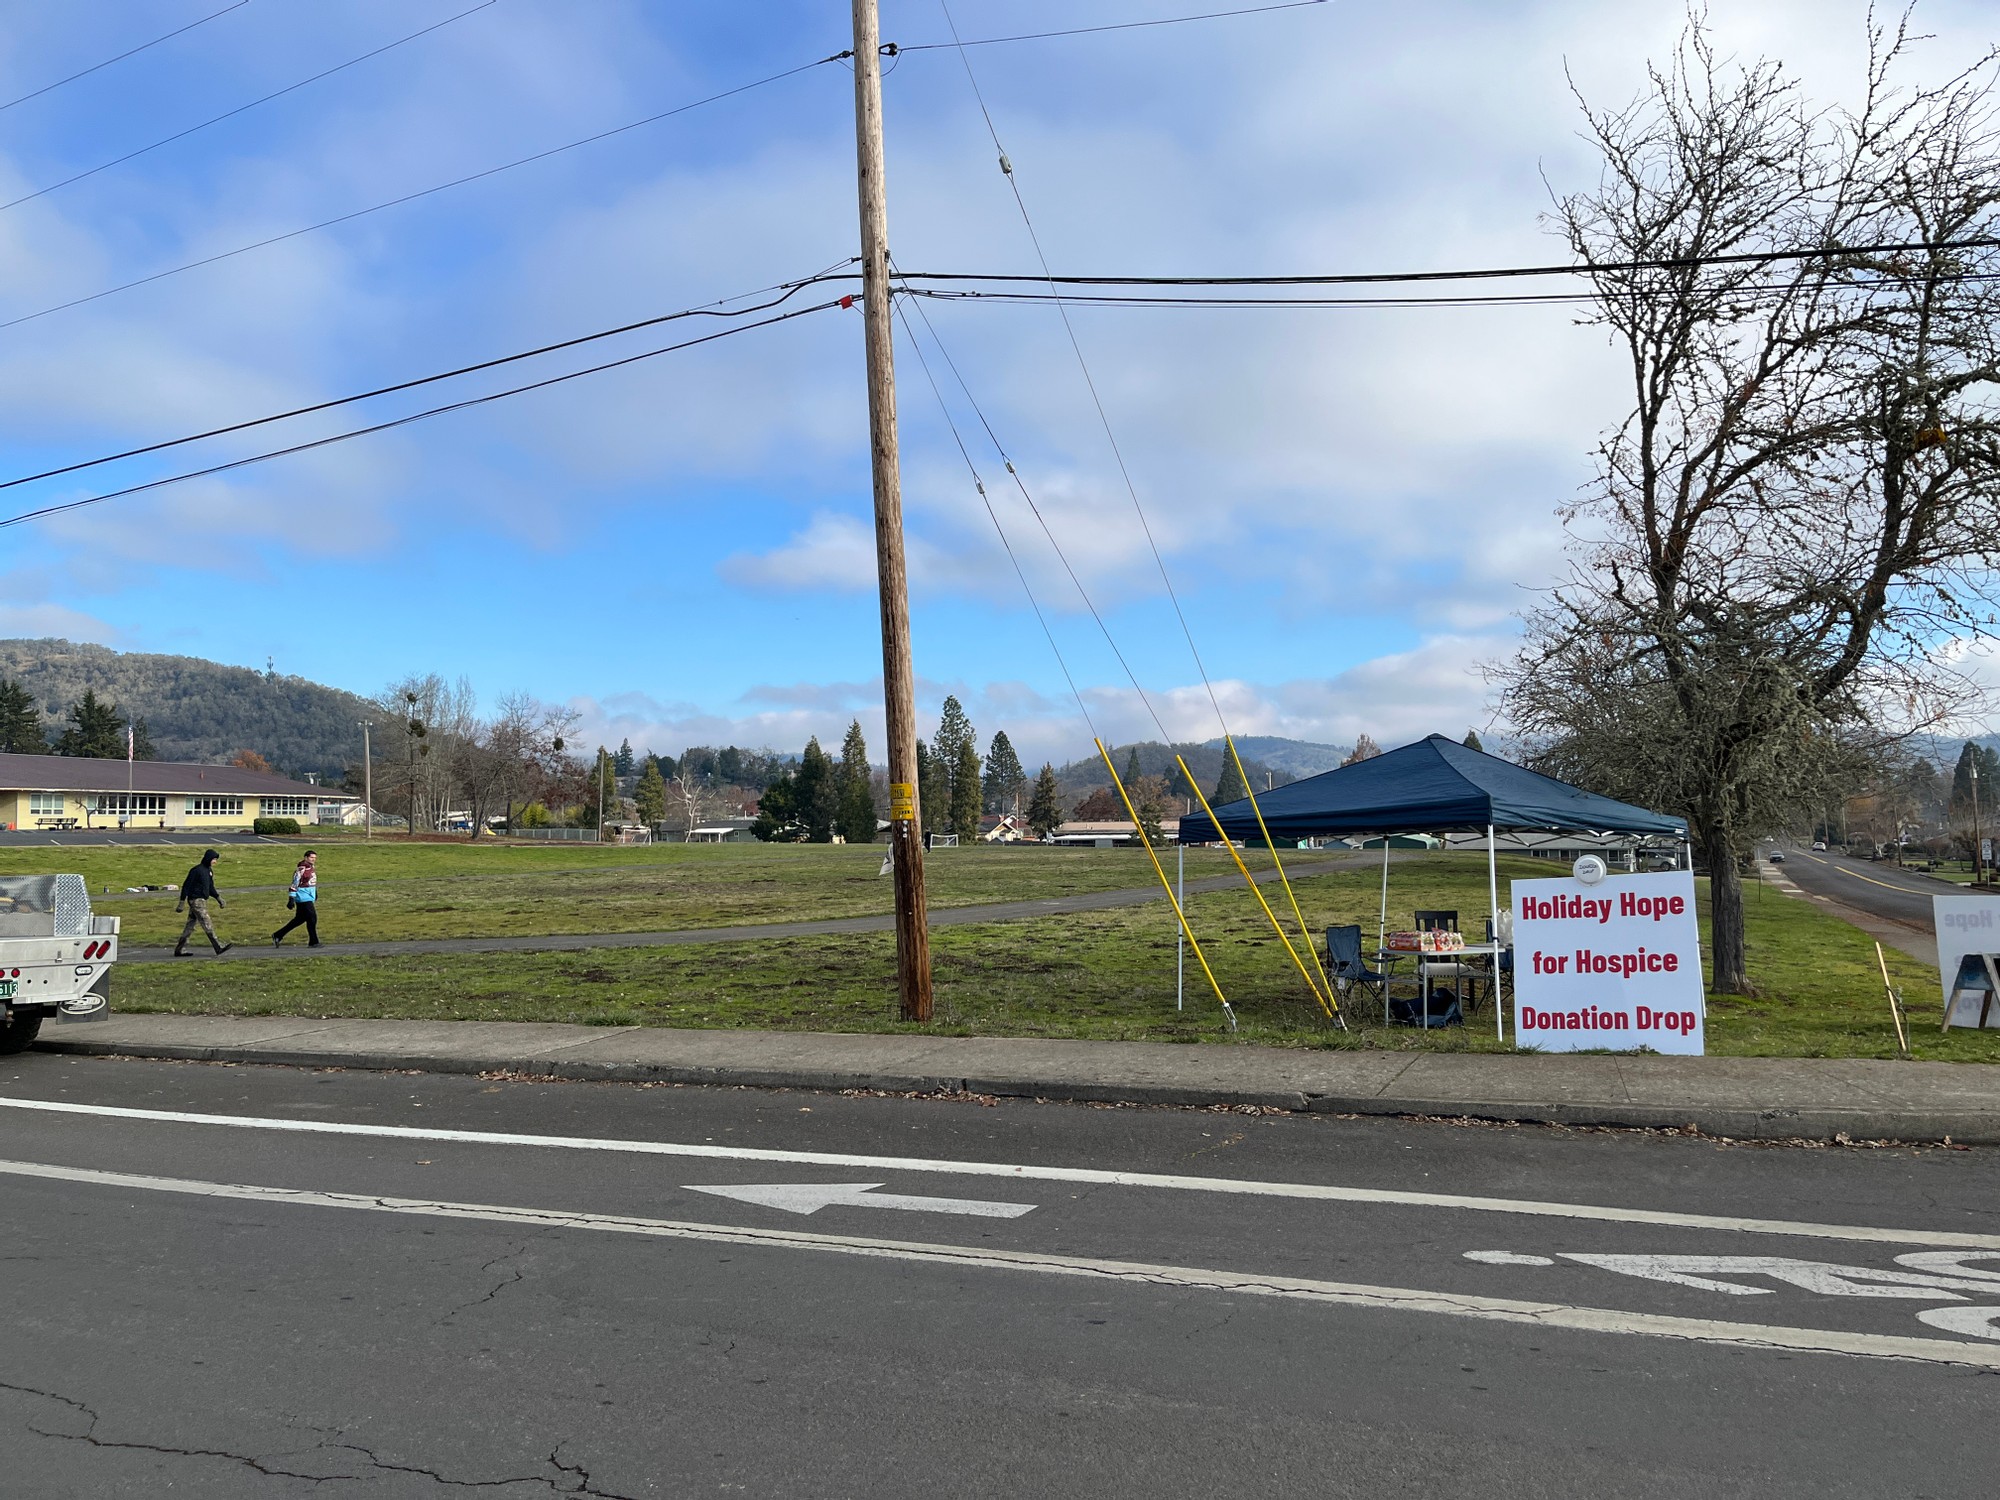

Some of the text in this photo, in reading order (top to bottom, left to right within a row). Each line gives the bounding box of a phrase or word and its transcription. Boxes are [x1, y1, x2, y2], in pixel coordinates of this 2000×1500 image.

[1522, 892, 1684, 924] Holiday Hope
[1533, 947, 1678, 979] for Hospice
[1522, 1005, 1696, 1036] Donation Drop
